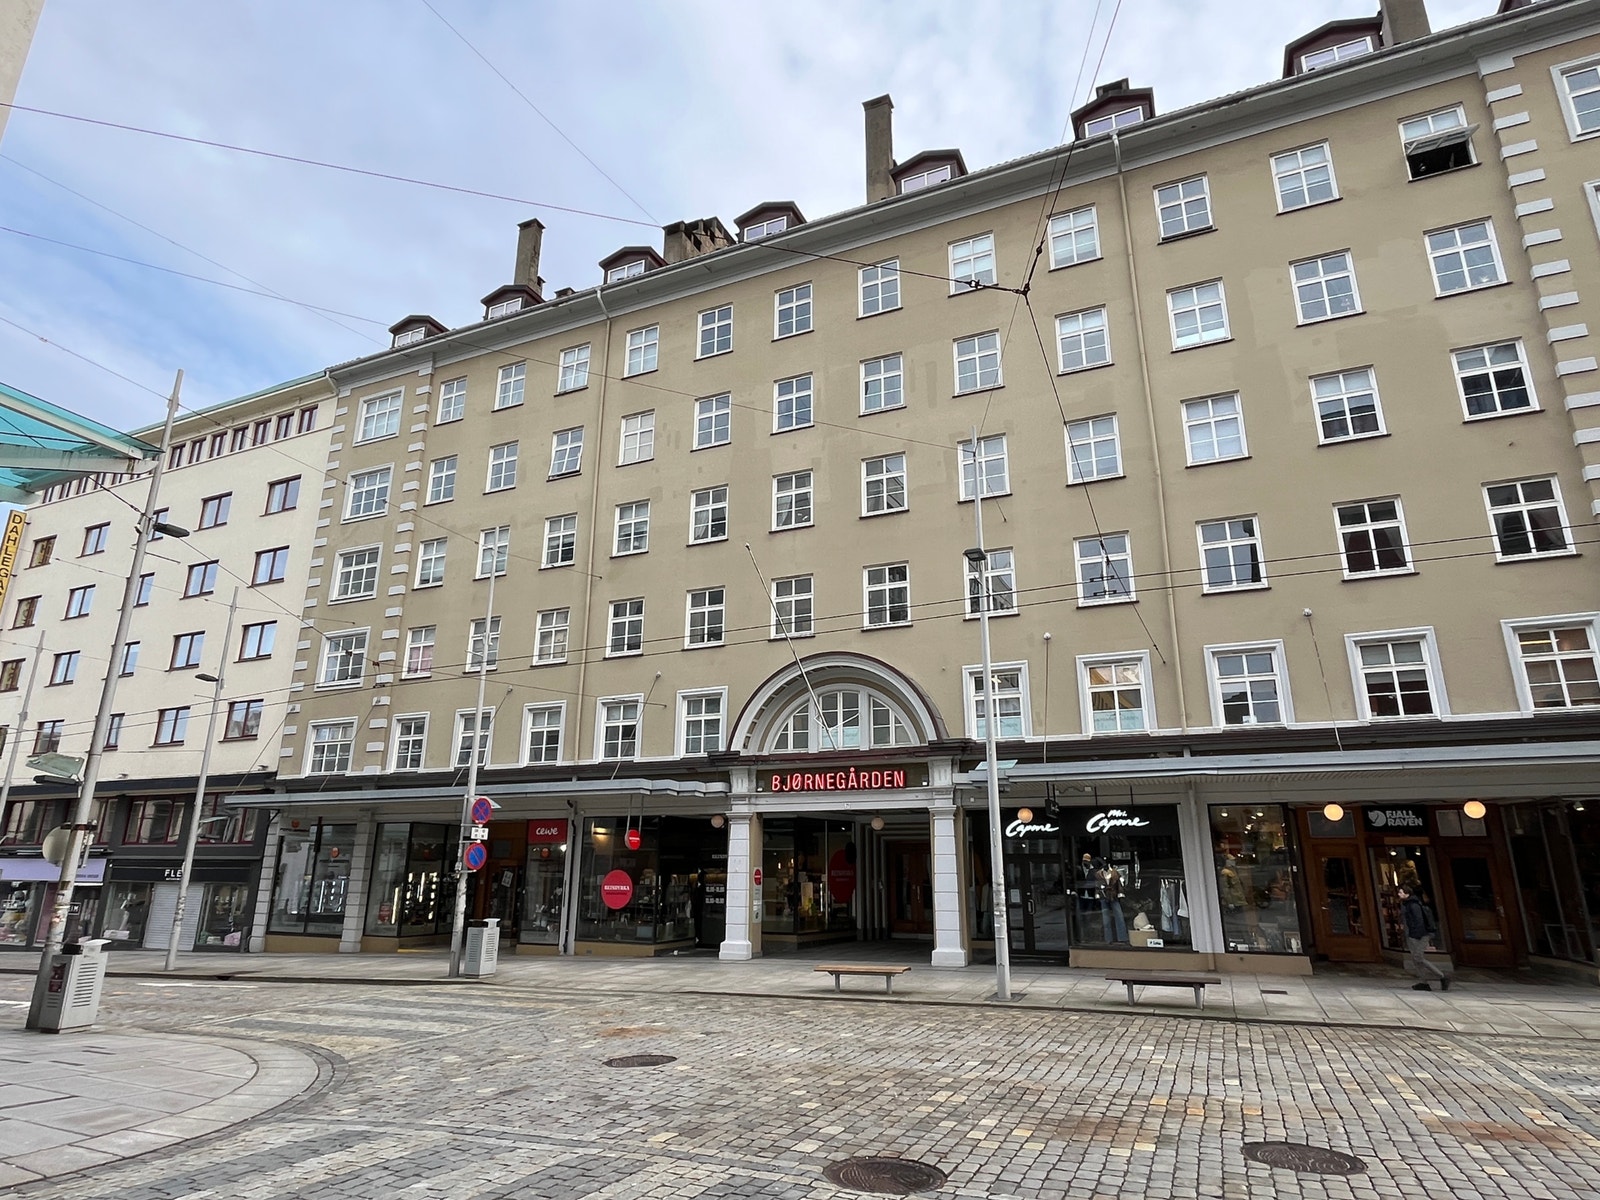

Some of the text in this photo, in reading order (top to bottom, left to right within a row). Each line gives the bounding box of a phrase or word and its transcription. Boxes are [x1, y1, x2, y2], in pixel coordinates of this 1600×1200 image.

[772, 767, 904, 791] BJØRNEGÅRDEN
[1005, 819, 1059, 838] Capone
[1086, 813, 1150, 833] Capone
[164, 869, 183, 878] FLE
